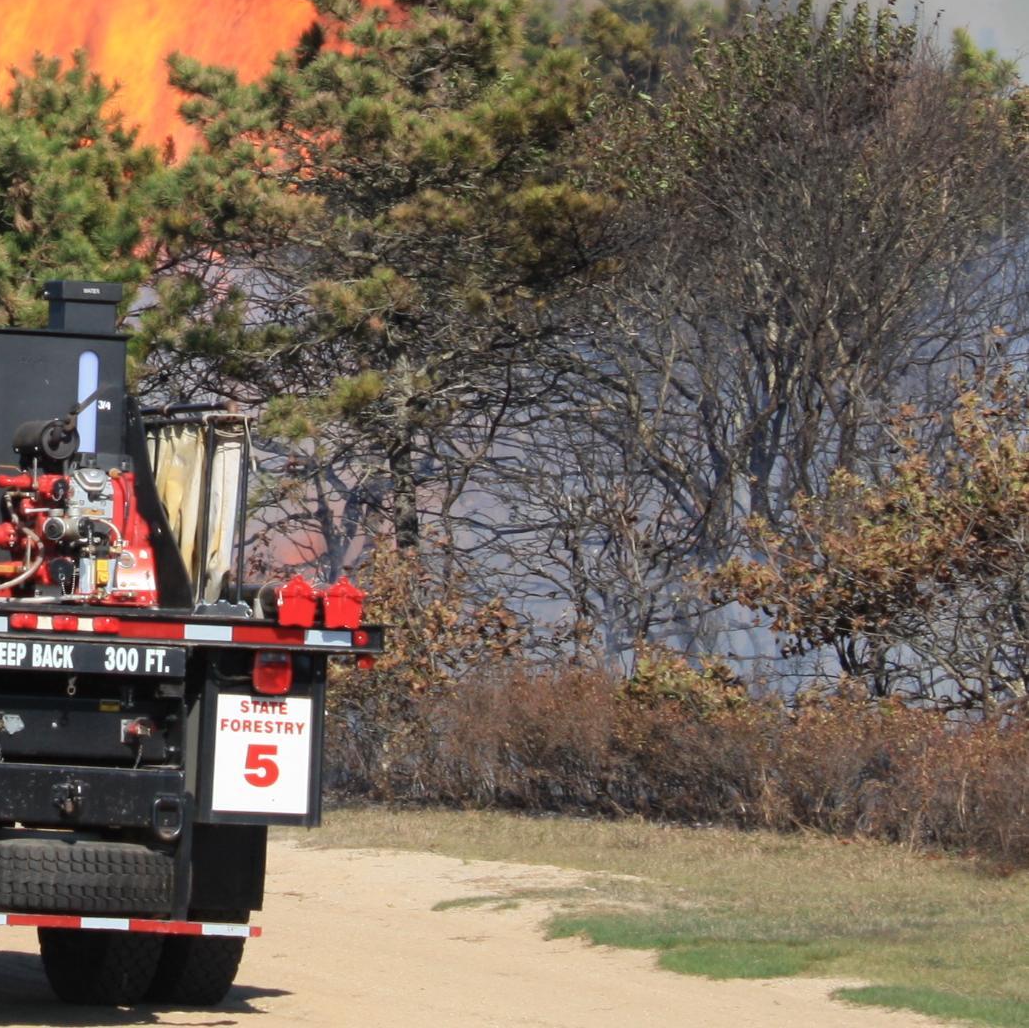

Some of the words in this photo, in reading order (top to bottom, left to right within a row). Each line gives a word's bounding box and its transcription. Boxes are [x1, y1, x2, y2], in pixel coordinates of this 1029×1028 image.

[97, 399, 112, 411] 3/4
[32, 643, 75, 669] BACK
[104, 646, 139, 672] 300
[145, 648, 171, 673] FT.
[240, 699, 289, 716] STATE
[220, 718, 306, 736] FORESTRY
[243, 743, 280, 788] 5
